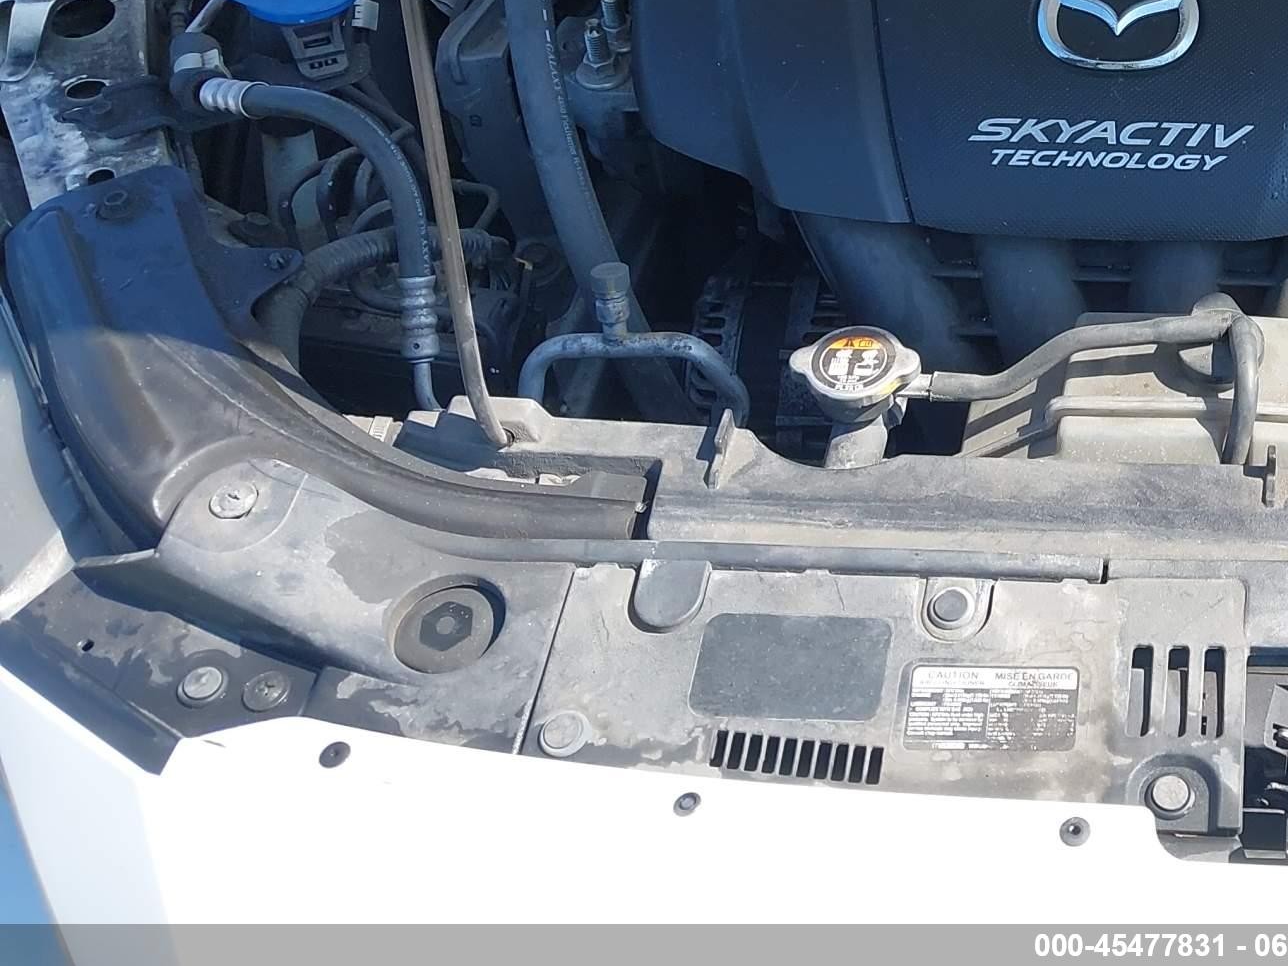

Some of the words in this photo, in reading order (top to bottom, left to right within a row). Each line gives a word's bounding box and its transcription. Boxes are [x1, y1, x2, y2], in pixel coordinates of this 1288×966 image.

[967, 117, 1255, 149] SKYACTIV
[990, 148, 1229, 172] TECHNOLOGY
[928, 671, 979, 680] CAUTION
[1022, 672, 1036, 681] EN
